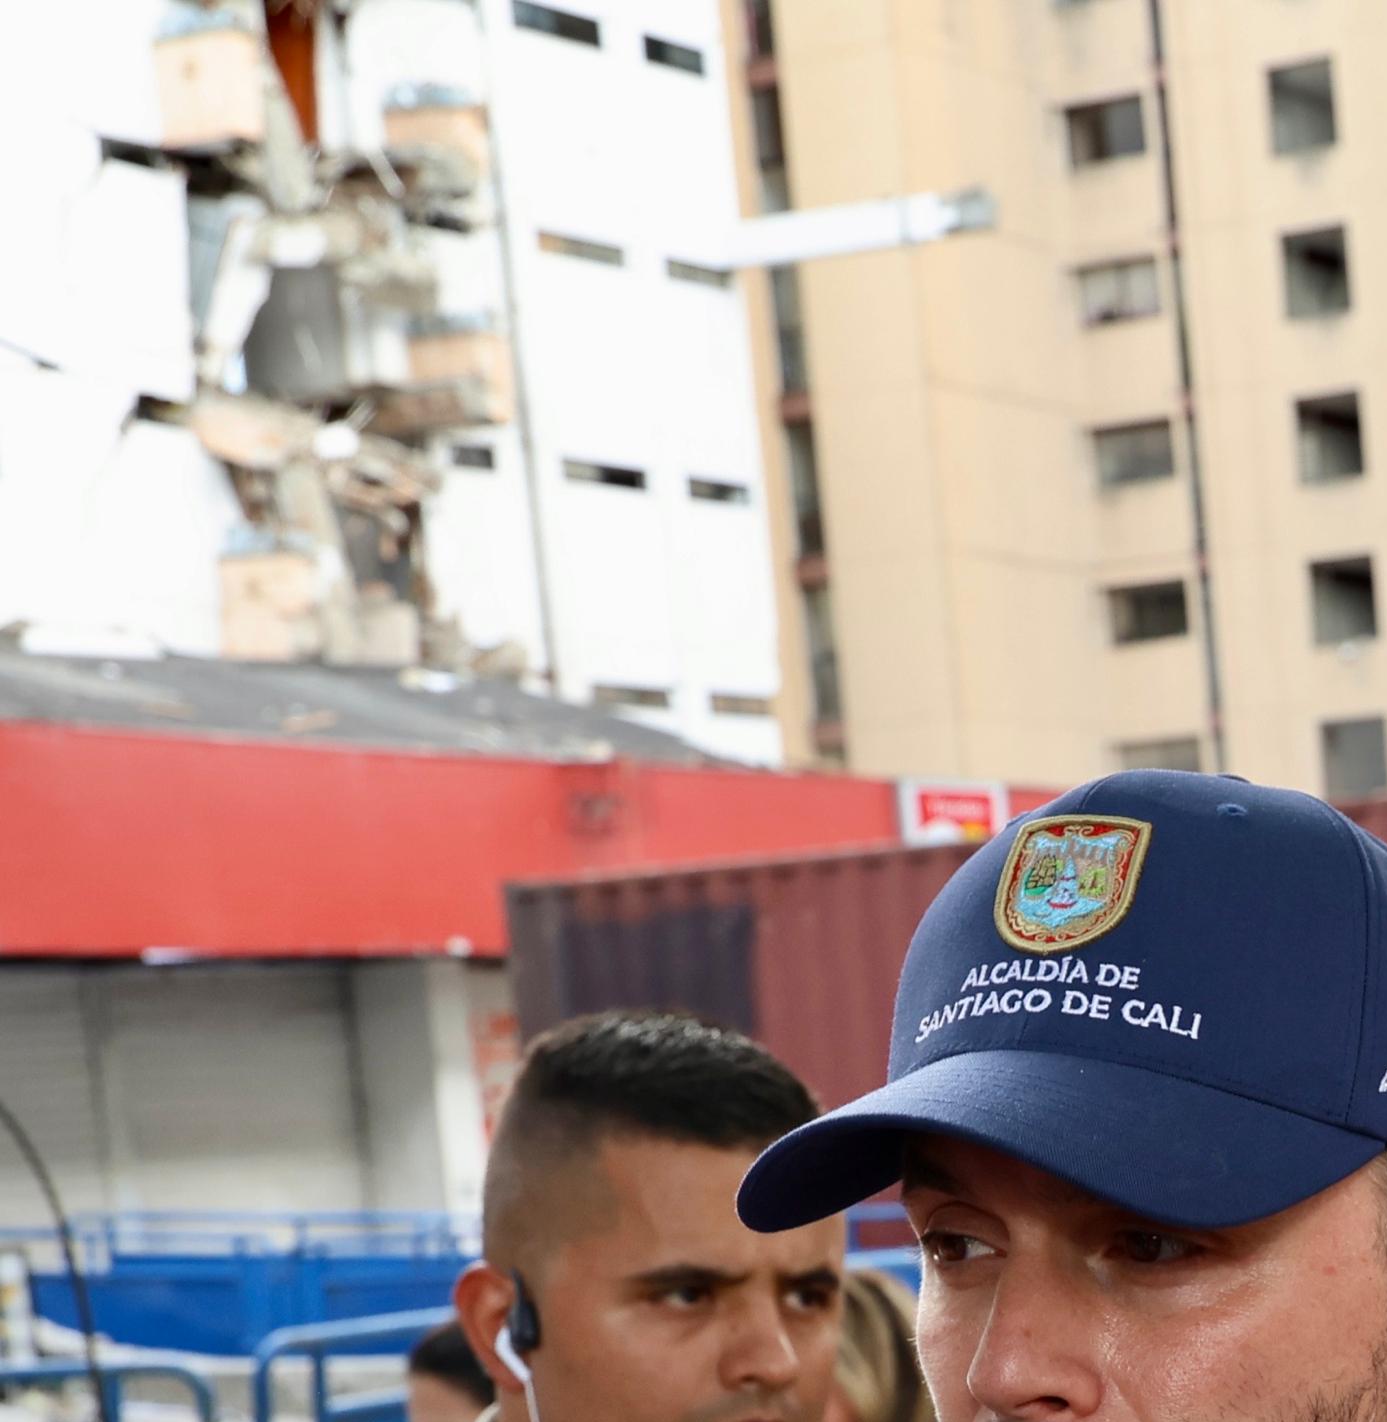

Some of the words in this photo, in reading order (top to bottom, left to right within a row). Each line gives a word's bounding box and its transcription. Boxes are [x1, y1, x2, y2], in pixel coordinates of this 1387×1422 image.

[960, 956, 1088, 992] ALCALDÍA
[1095, 963, 1141, 990] DE
[915, 988, 1052, 1043] SANTIAGO
[1061, 990, 1112, 1020] DE
[1121, 1000, 1202, 1040] CALI
